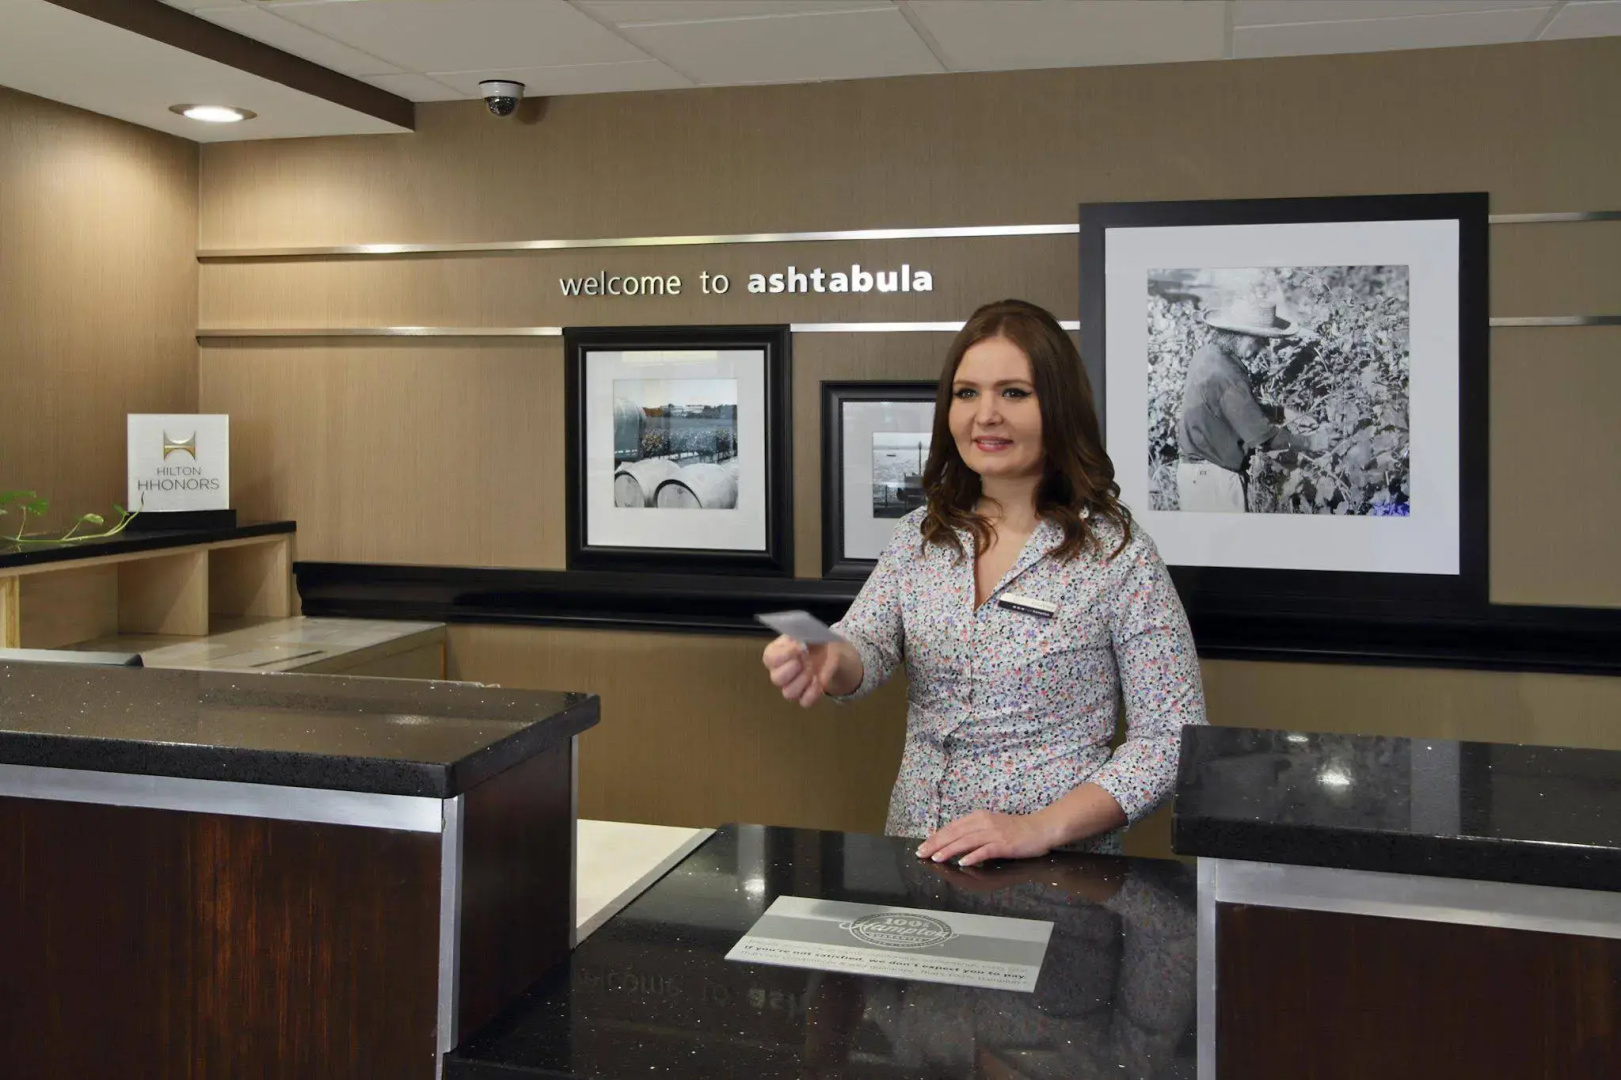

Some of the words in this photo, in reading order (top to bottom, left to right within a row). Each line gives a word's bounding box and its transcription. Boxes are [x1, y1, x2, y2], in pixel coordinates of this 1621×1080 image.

[559, 271, 683, 297] welcome
[700, 271, 731, 296] to
[747, 264, 934, 294] ashtabula
[156, 466, 202, 476] HILTON
[137, 478, 220, 491] HHONORS
[922, 964, 960, 972] expect
